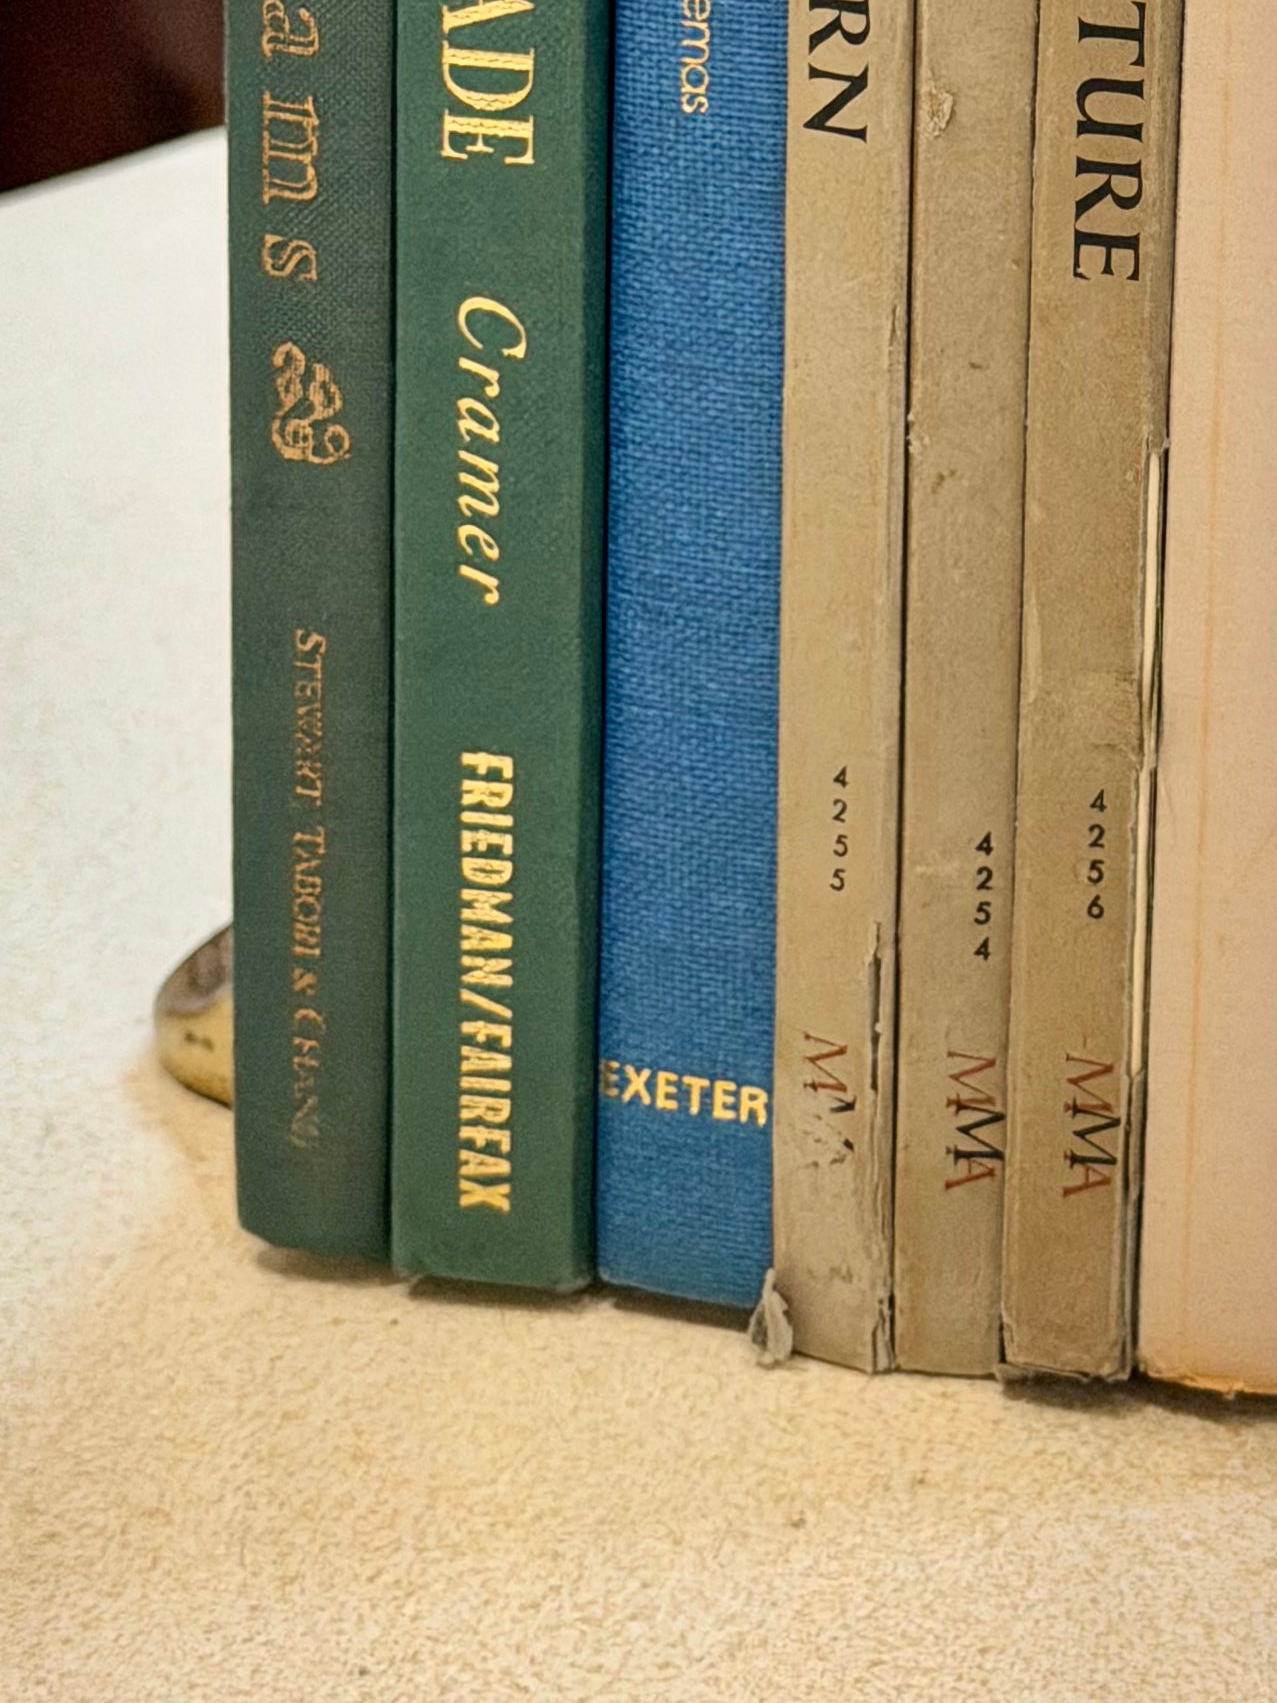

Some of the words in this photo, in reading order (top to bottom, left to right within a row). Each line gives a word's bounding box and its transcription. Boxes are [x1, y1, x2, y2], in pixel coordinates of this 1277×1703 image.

[457, 296, 527, 605] Cramer
[458, 750, 514, 1214] FRIEDMAN/FAIRFAX
[600, 1058, 770, 1128] EXETER
